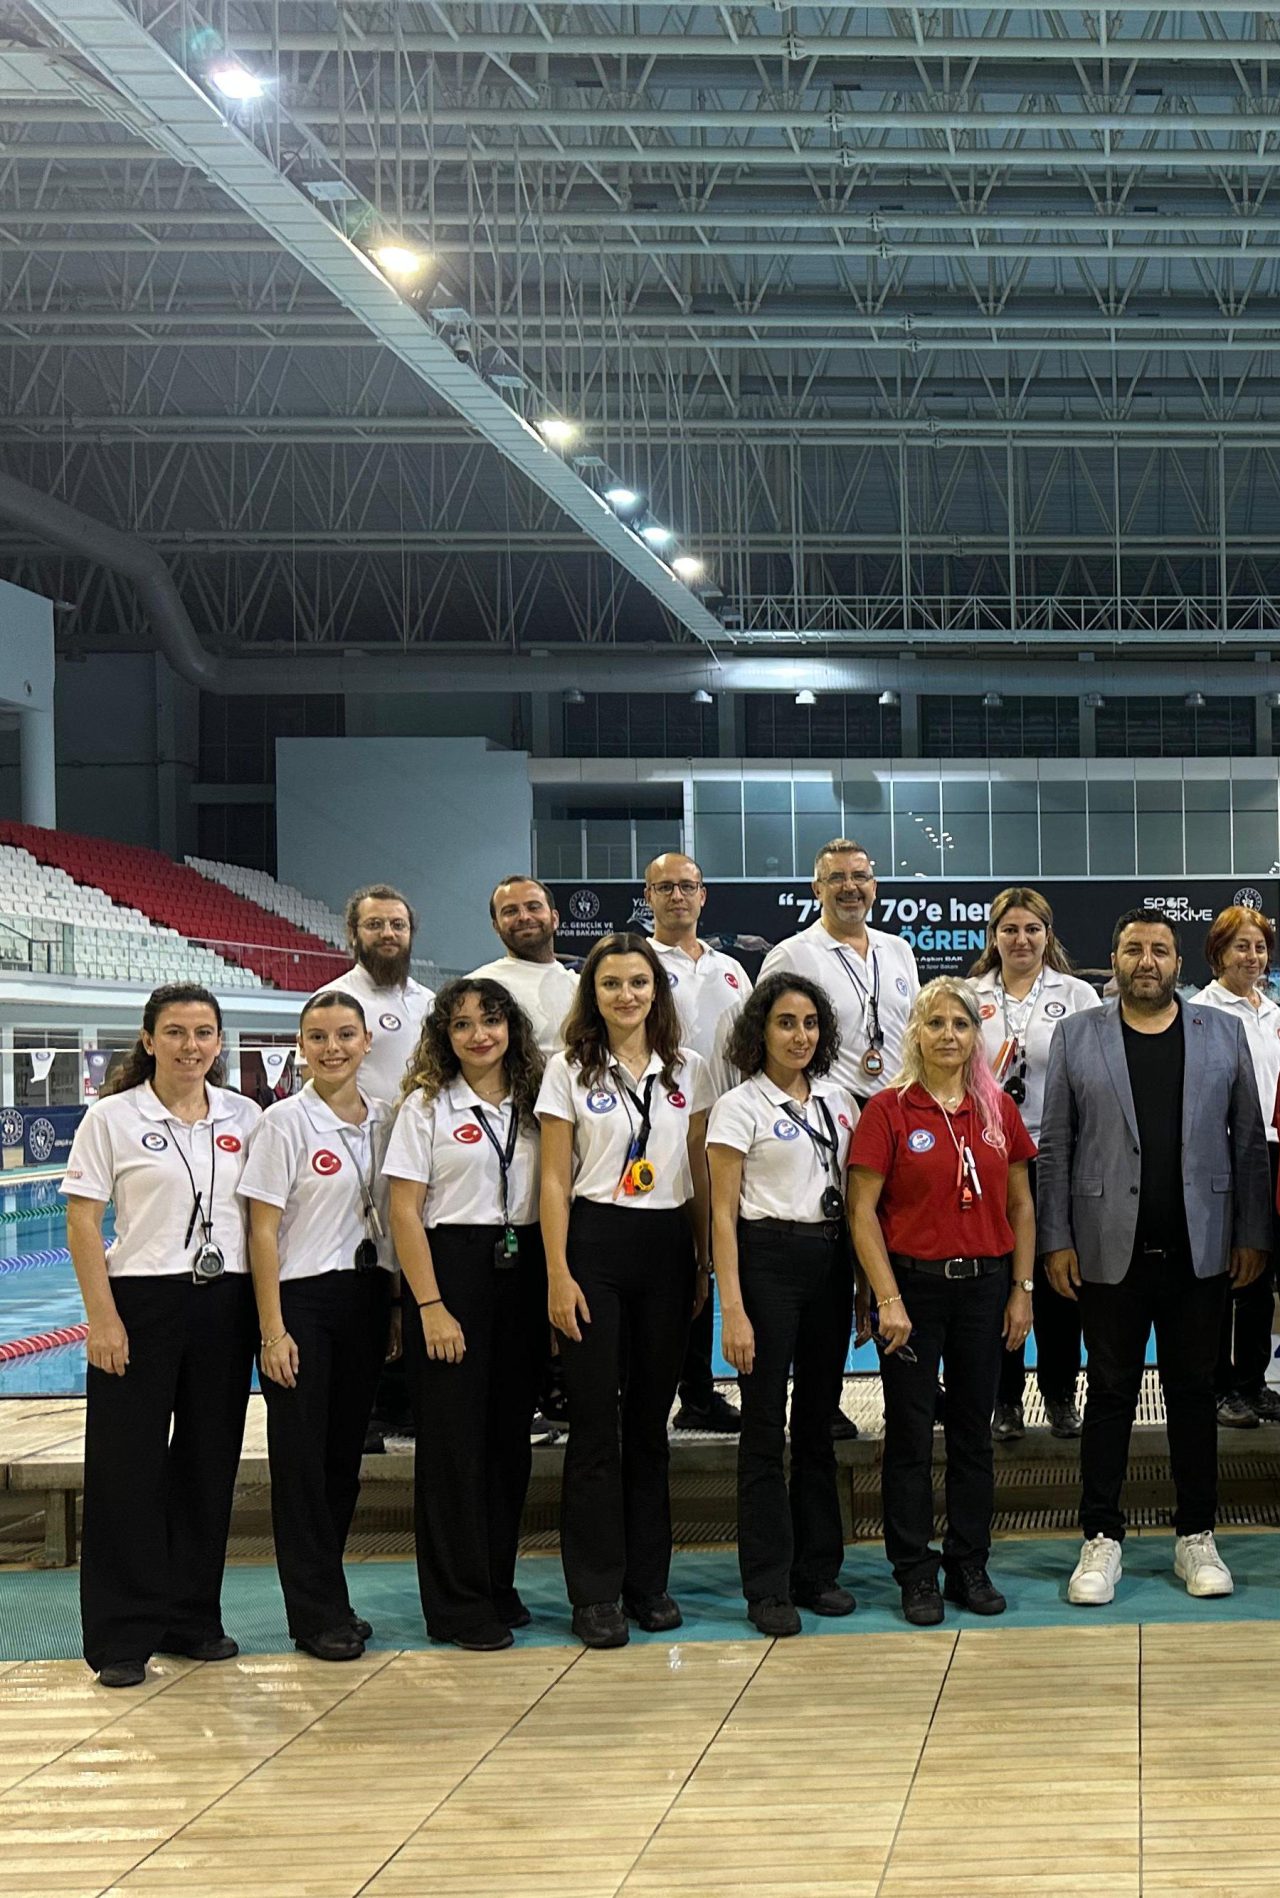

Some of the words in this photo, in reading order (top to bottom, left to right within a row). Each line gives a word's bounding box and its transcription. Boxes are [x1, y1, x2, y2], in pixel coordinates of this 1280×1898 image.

[1143, 897, 1189, 909] SPOR
[571, 920, 602, 930] GENÇLİK
[576, 928, 614, 936] BAKANLIĞI
